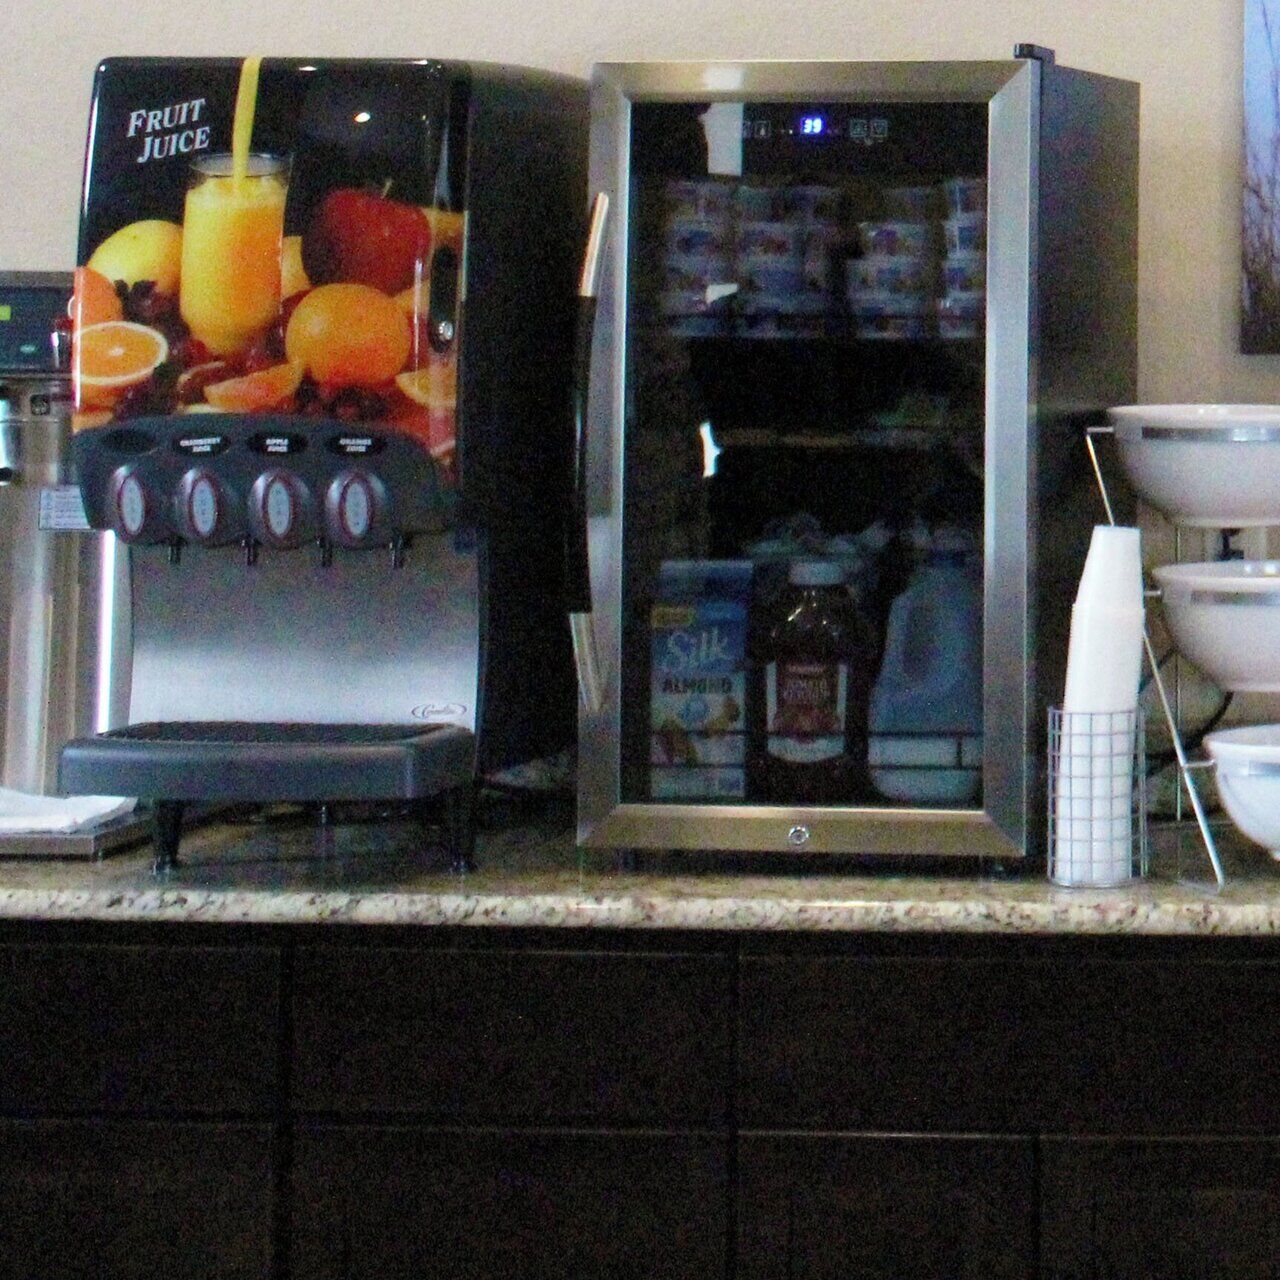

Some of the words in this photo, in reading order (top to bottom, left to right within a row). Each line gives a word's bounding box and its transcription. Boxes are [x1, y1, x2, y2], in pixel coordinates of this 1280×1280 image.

[126, 98, 206, 138] FRUIT
[803, 117, 823, 134] 39
[136, 126, 211, 164] JUICE
[662, 626, 732, 670] Silk
